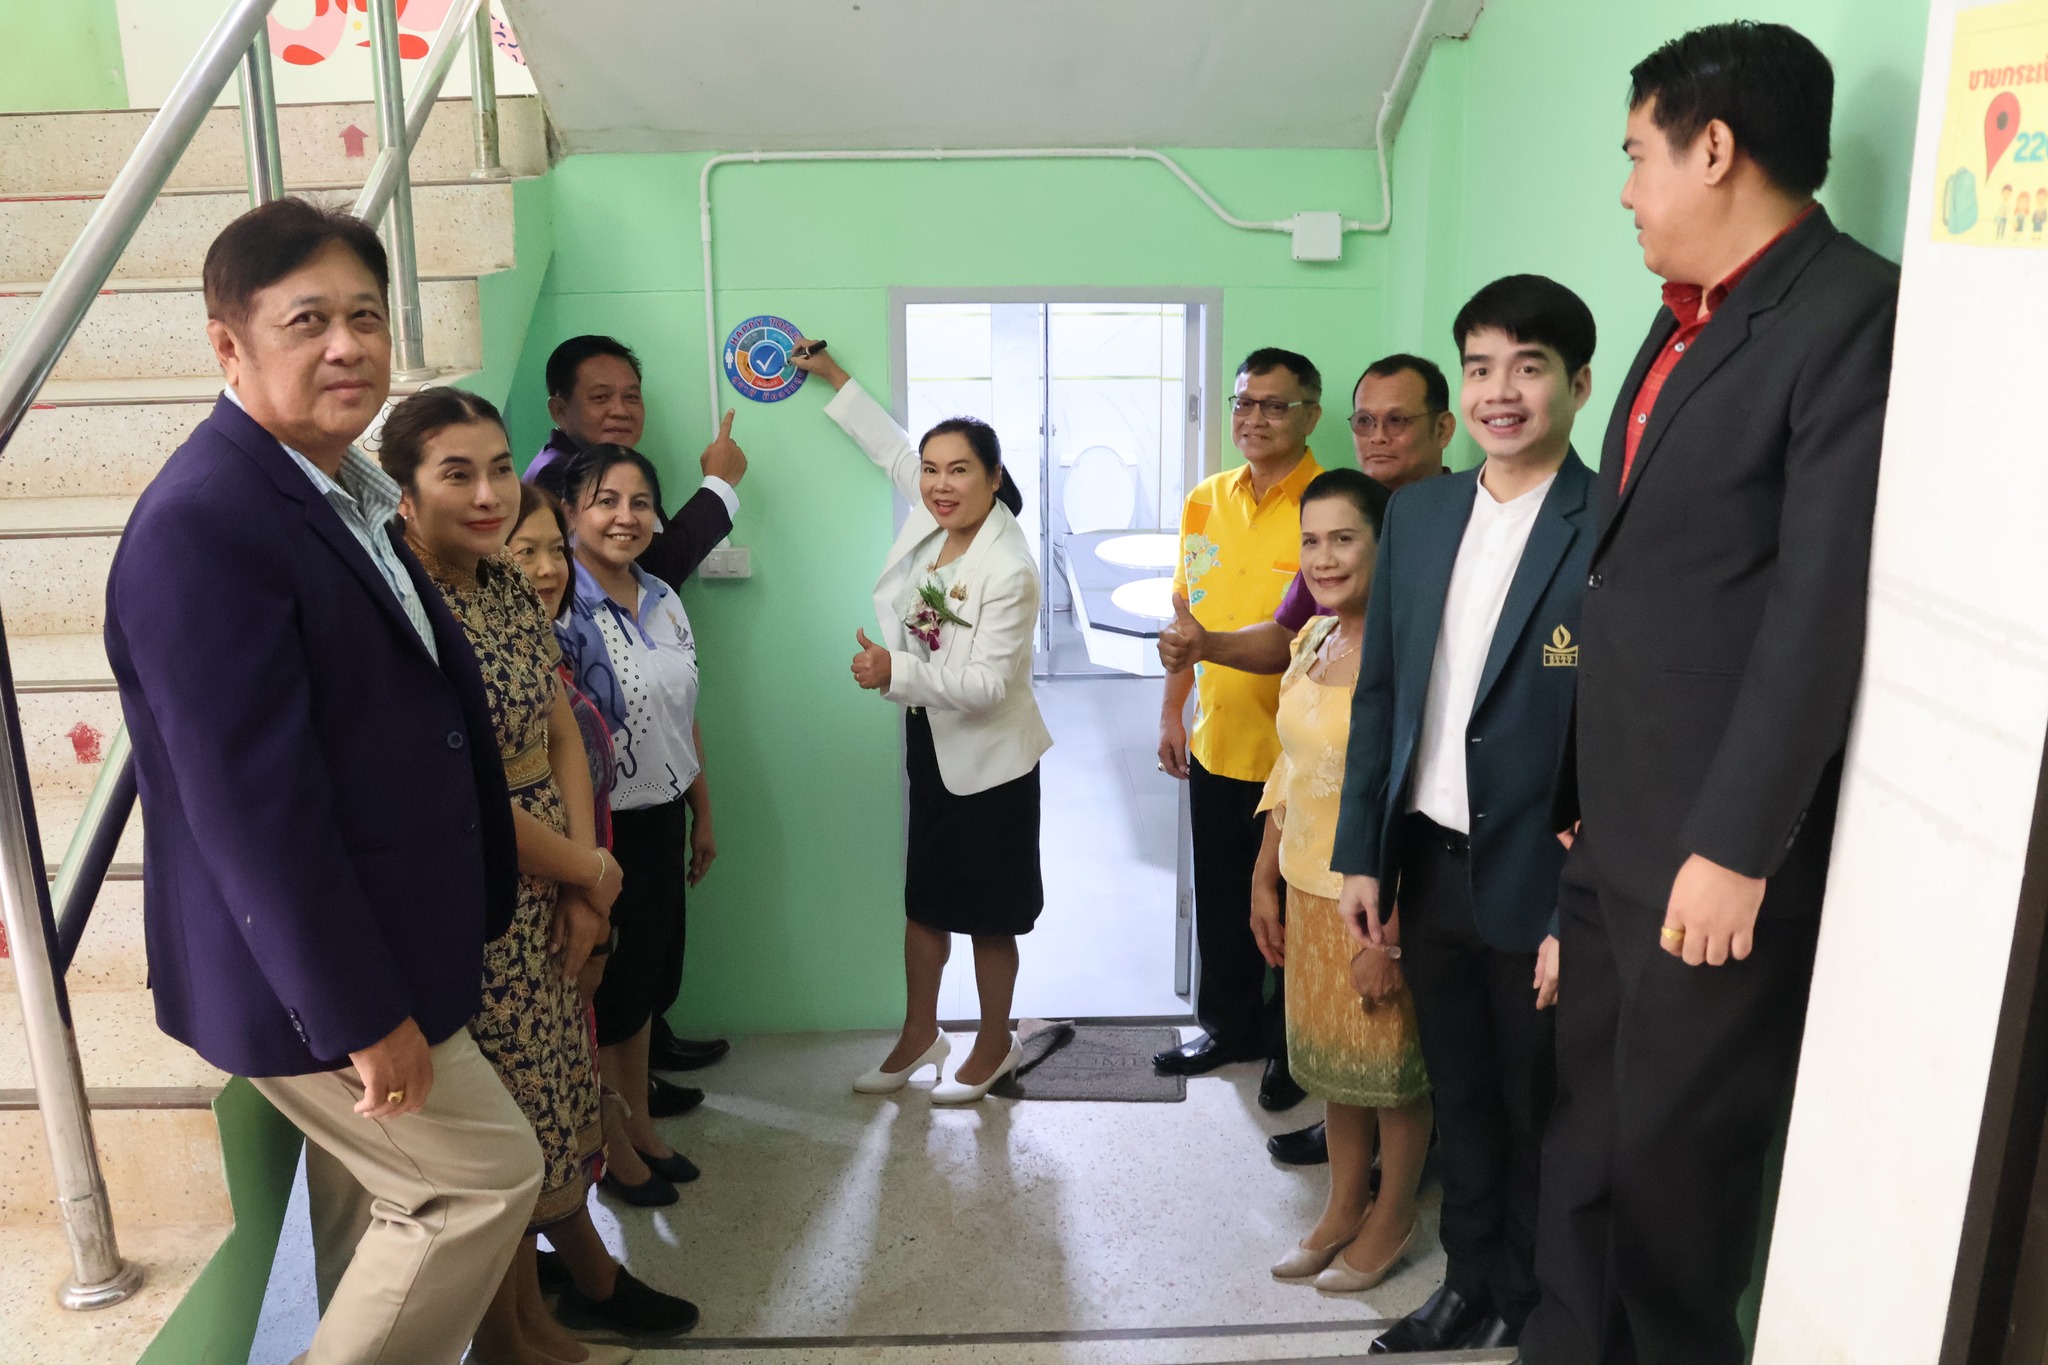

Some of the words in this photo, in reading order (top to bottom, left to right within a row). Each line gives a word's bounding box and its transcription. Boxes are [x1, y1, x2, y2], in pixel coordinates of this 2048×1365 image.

[2013, 131, 2048, 162] 22
[730, 318, 763, 346] HAPPY
[768, 318, 800, 342] TOILE
